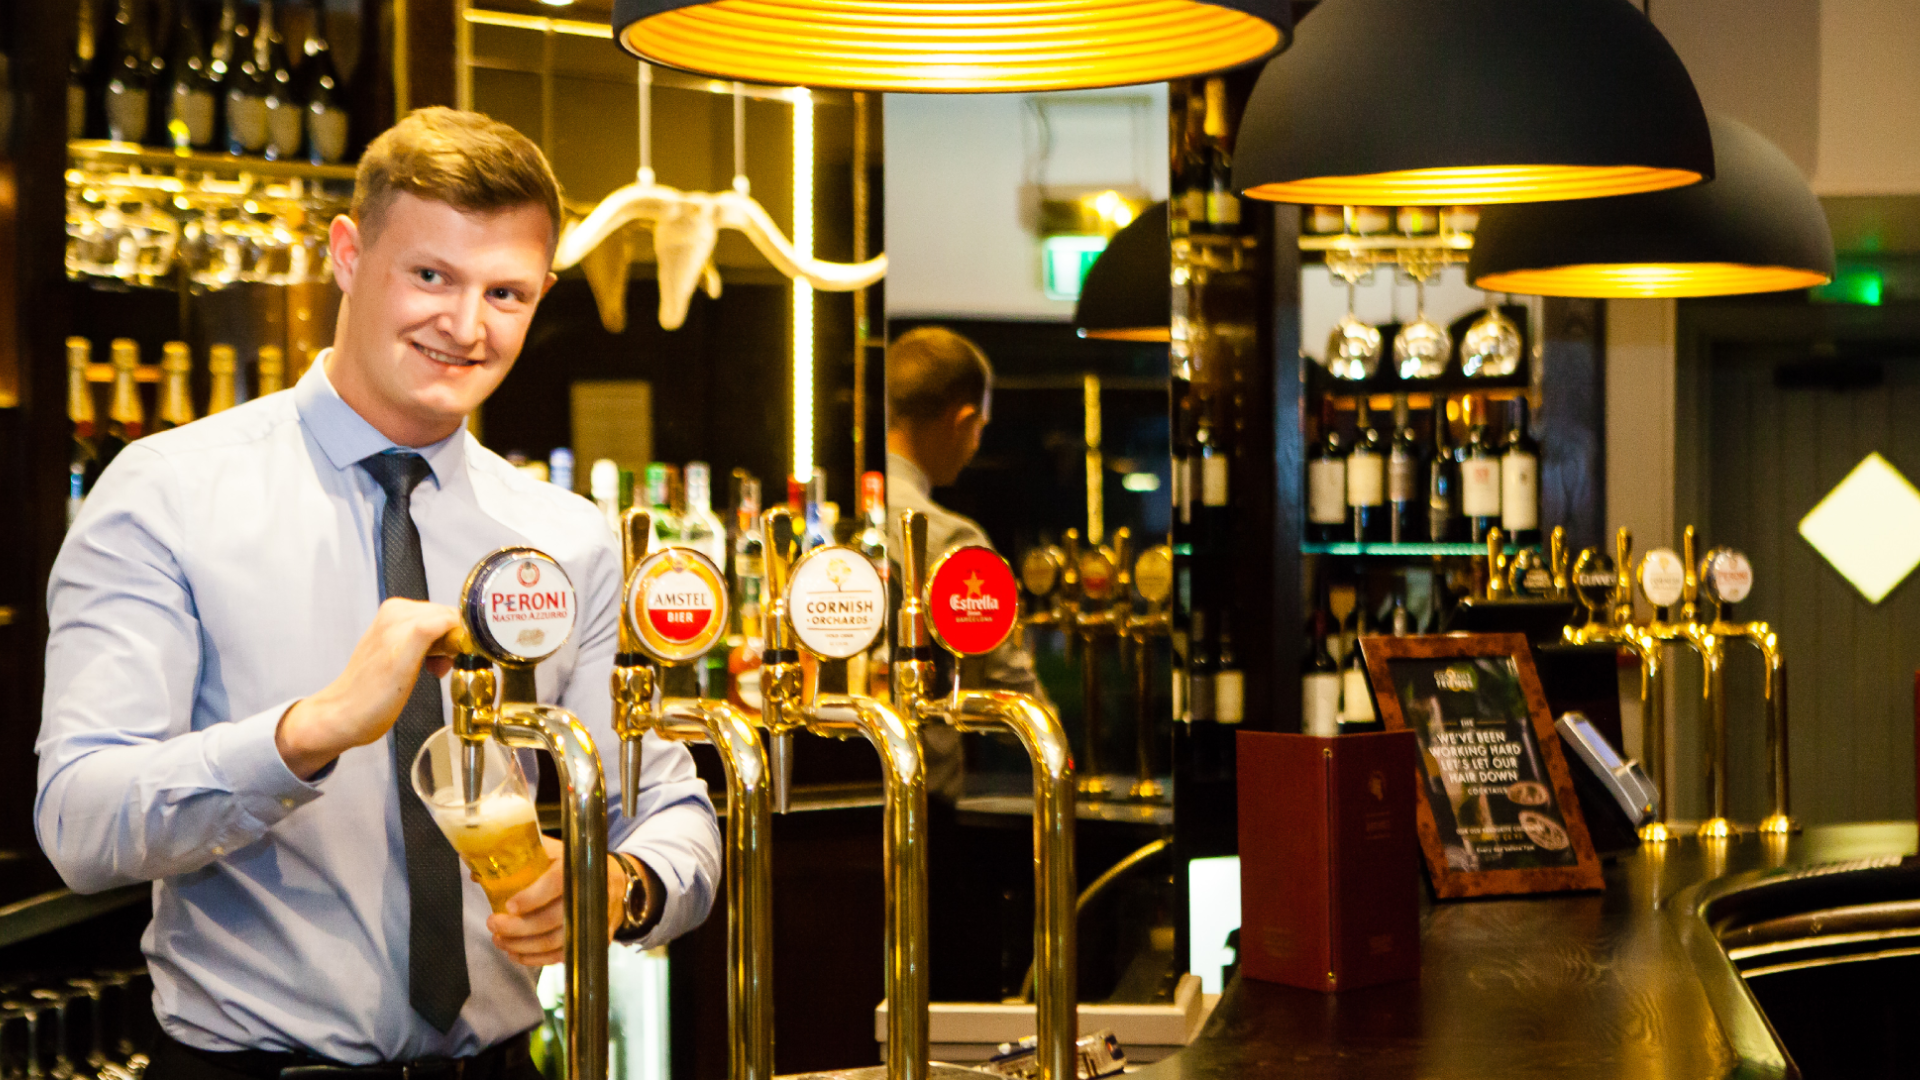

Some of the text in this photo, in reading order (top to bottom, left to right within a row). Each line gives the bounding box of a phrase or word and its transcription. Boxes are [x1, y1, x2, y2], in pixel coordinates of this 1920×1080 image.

[492, 591, 567, 613] PERONI
[654, 592, 708, 607] AMSTEL
[949, 594, 1000, 611] Estrella
[806, 601, 873, 614] CORNISH
[492, 609, 568, 623] NASTRO AZZURRO
[667, 611, 695, 623] BIER
[811, 615, 868, 625] ORCHARDS
[1460, 718, 1474, 727] THE
[1436, 731, 1507, 745] WE'VE BEEN
[1428, 744, 1522, 758] WORKING HARD
[1440, 756, 1518, 771] LET'S LET OUR
[1449, 771, 1519, 784] HAIR DOWN
